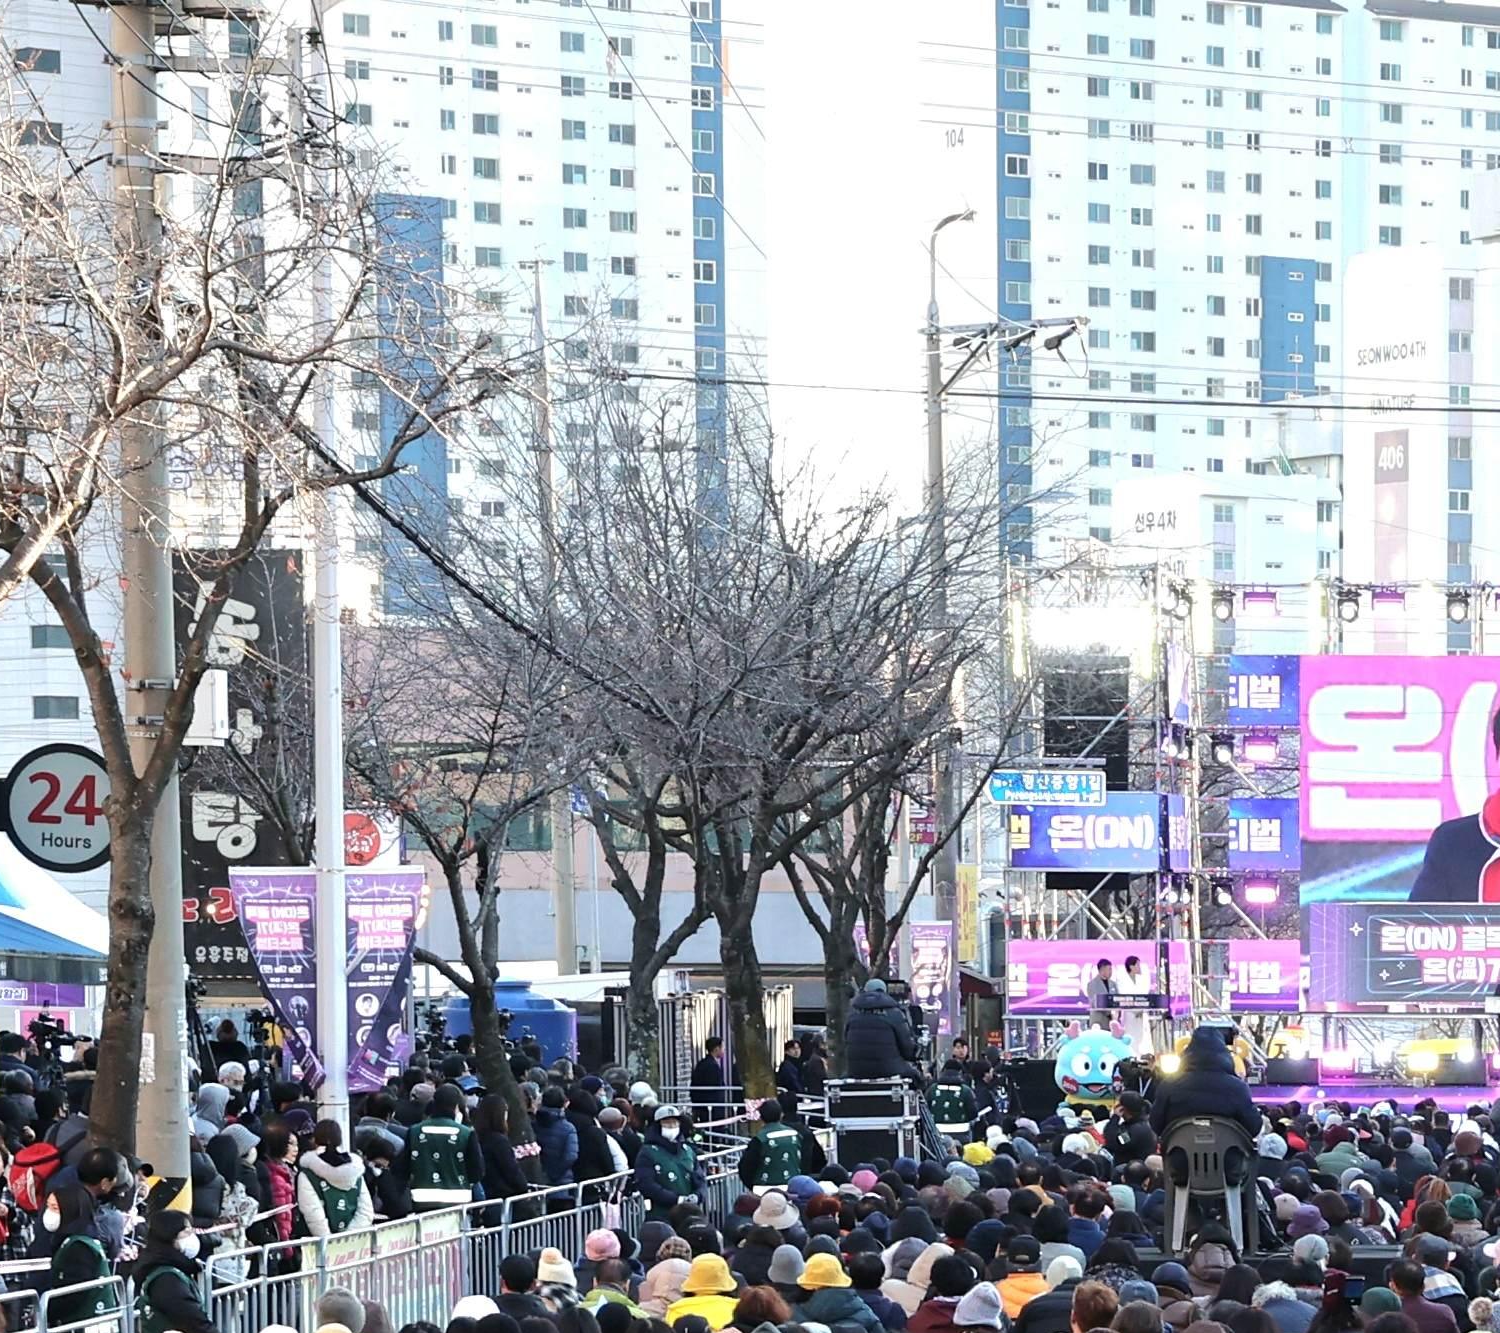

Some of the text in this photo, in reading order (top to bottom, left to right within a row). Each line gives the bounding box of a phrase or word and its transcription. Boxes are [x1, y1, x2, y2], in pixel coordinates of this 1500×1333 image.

[28, 772, 103, 827] 24
[41, 832, 92, 849] Hours
[1050, 815, 1155, 849] 온(ON)
[1380, 925, 1457, 952] 온(ON)
